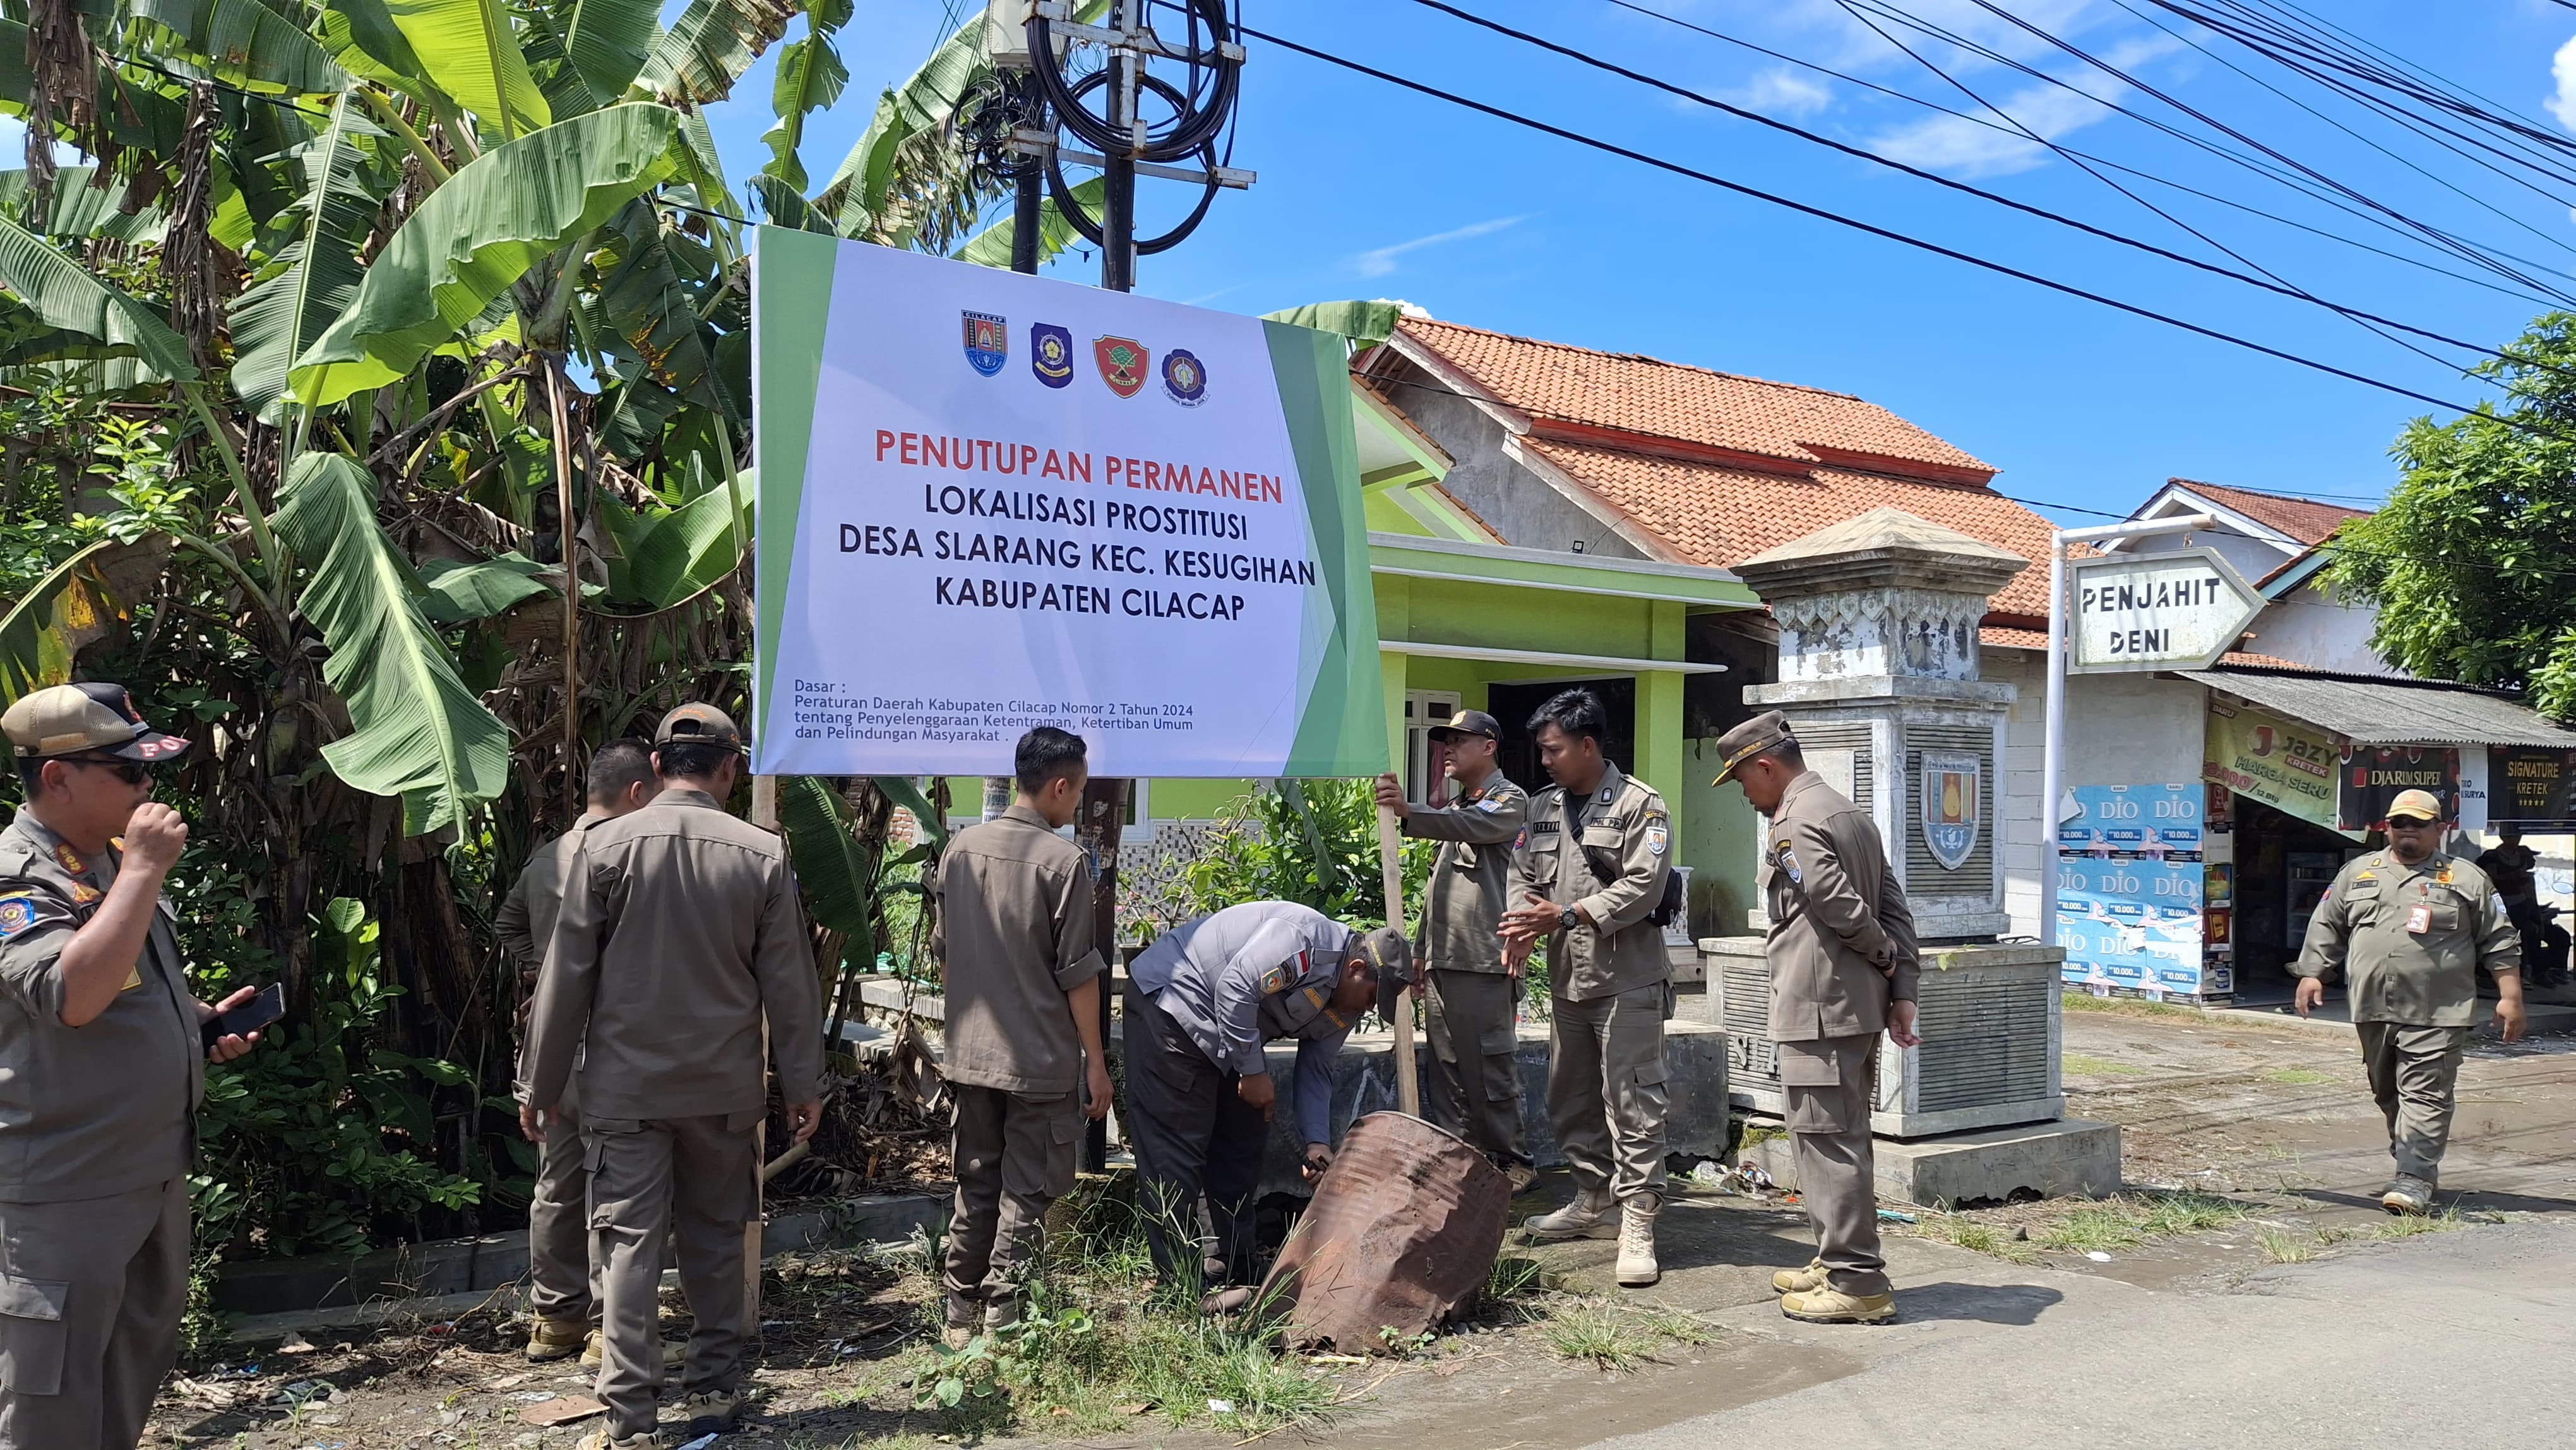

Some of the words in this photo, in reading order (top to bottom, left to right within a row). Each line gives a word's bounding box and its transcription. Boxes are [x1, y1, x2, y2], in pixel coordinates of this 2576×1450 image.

[965, 312, 1003, 321] CILACAP
[876, 429, 1092, 482] PENUTUPAN
[1106, 455, 1282, 504] PERMANEN
[926, 484, 1095, 527] LOKALISASI
[1107, 501, 1248, 541] PROSTITUSI
[840, 523, 924, 558] DESA
[934, 530, 1081, 569] SLARANG
[1092, 543, 1155, 575] KEC.
[1165, 549, 1316, 586] KESUGIHAN
[936, 576, 1111, 614] KABUPATEN
[1121, 588, 1244, 621] CILACAP
[2082, 578, 2220, 614] PENJAHIT
[2110, 628, 2169, 654] DENI
[795, 680, 835, 692] Dasar
[795, 695, 868, 708] Peraturan
[873, 697, 923, 710] Daerah
[929, 698, 1003, 714] Kabupaten
[1008, 700, 1056, 718] Cilacap
[1061, 702, 1104, 714] Nomor
[1109, 704, 1116, 714] 2
[1120, 704, 1158, 716] Tahun
[1162, 704, 1193, 716] 2024
[2212, 705, 2234, 717] BARU
[794, 711, 852, 726] tentang
[858, 712, 979, 728] Penyelenggaraan
[984, 715, 1076, 730] Ketentraman,
[1082, 716, 1149, 729] Ketertiban
[1154, 718, 1193, 730] Umum
[795, 726, 821, 738] dan
[827, 726, 917, 742] Pelindungan
[922, 728, 1000, 743] Masyarakat
[2286, 757, 2327, 777] KRETEK
[2507, 761, 2560, 778] SIGNATURE
[2371, 770, 2412, 786] DJARUM
[2413, 770, 2441, 786] SUPER
[2517, 782, 2548, 794] KRETEK
[2287, 777, 2330, 800] SERU
